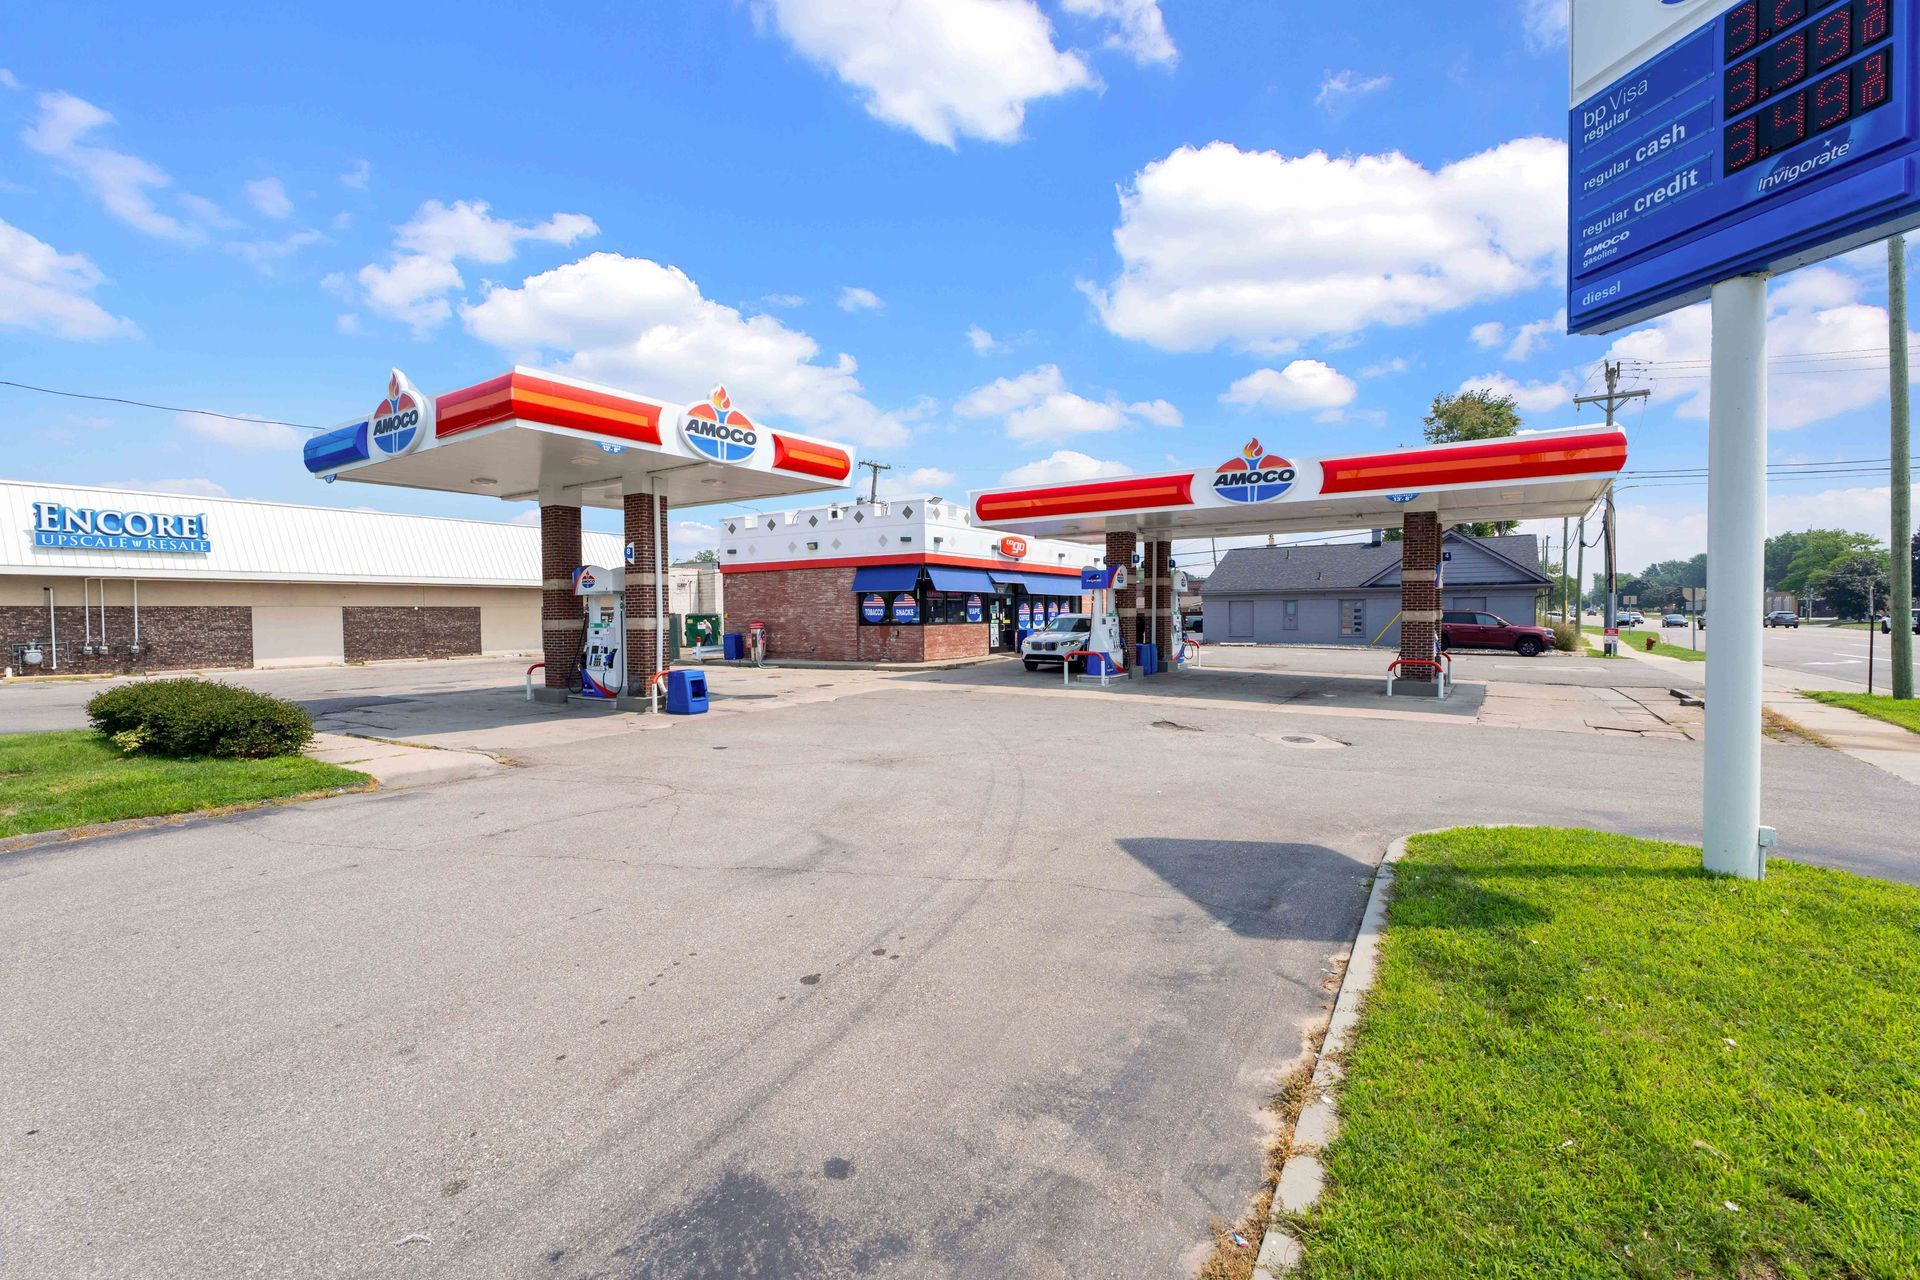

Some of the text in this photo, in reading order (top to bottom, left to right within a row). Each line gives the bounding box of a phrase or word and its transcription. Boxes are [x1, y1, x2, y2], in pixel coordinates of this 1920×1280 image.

[1730, 9, 1849, 111] 3.39
[1584, 79, 1648, 129] bp Visa
[1584, 108, 1631, 143] regular
[1730, 72, 1848, 168] 3.49
[1584, 123, 1686, 191] regular cash
[1757, 142, 1850, 192] Invigorate
[1582, 168, 1699, 238] regular credit
[1583, 230, 1631, 258] AMOCO
[1583, 246, 1618, 269] gasoline
[1582, 280, 1621, 307] diesel
[373, 409, 419, 436] AMOCO
[685, 419, 758, 446] AMOCO
[1213, 469, 1296, 487] AMOCO
[35, 501, 209, 540] ENCORE!
[41, 534, 209, 551] UPSCALE RESALE
[1012, 541, 1026, 554] go
[864, 608, 883, 617] TOBACCO
[895, 608, 914, 617] SNACKS
[968, 607, 981, 616] VAPE
